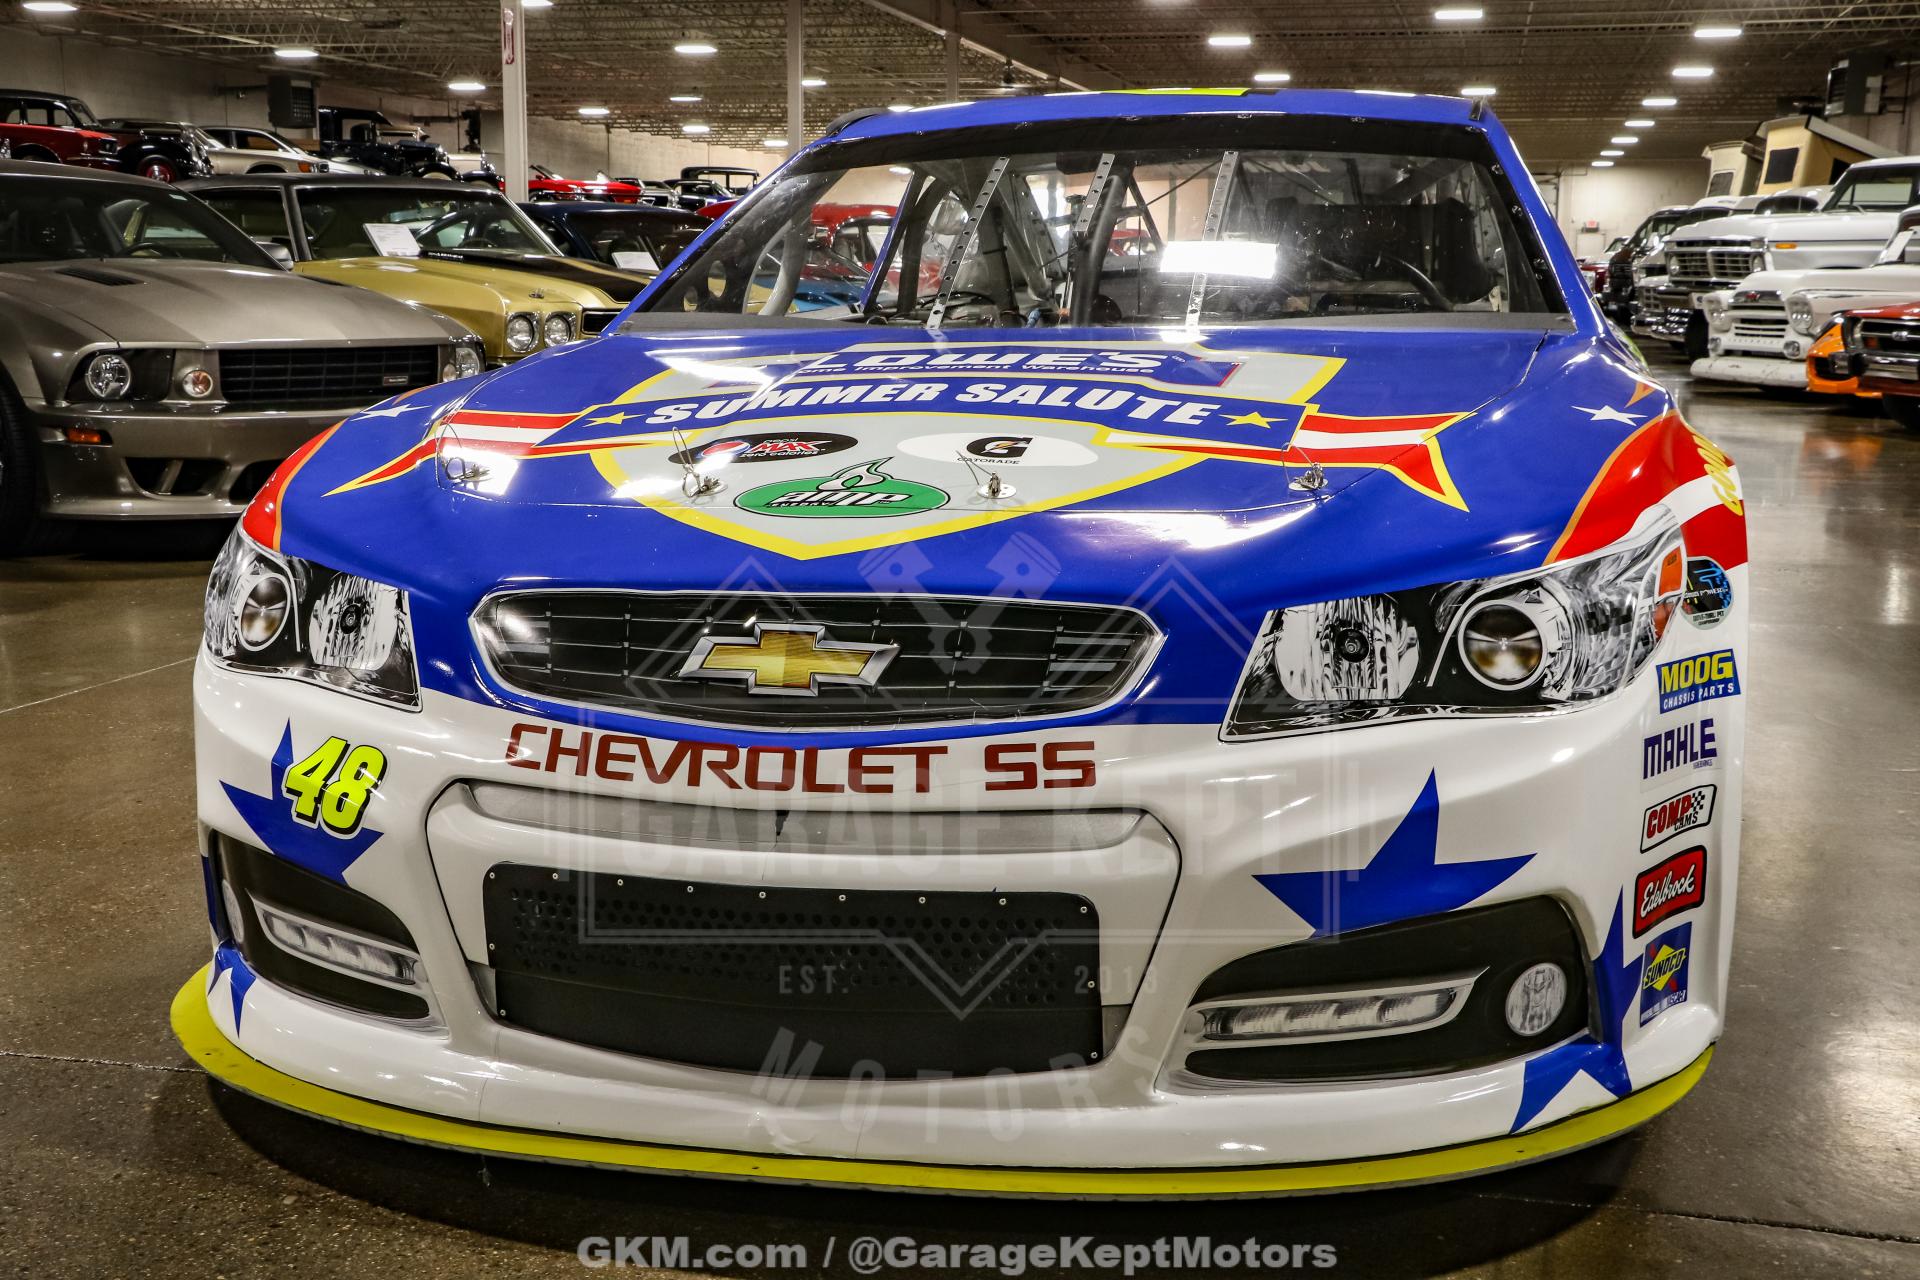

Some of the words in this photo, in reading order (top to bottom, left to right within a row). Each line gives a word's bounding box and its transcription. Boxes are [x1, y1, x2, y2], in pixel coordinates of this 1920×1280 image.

[802, 351, 1168, 369] LOWE'S
[854, 364, 1011, 372] Improvement
[1022, 364, 1155, 374] Warehouse
[645, 383, 948, 424] SUMMER
[955, 383, 1222, 425] SALUTE
[745, 440, 832, 452] MAX
[769, 449, 819, 457] calories
[957, 457, 1021, 465] GATORADE
[966, 436, 1034, 458] G
[1660, 651, 1734, 695] MOOG
[1663, 690, 1696, 710] CHASSIS
[1698, 682, 1735, 699] PARTS
[504, 722, 949, 793] CHEVROLET
[984, 740, 1097, 791] SS
[1642, 717, 1718, 780] MAHLE
[284, 735, 388, 836] 48
[1646, 794, 1692, 840] COMP
[1674, 810, 1699, 832] CAMS
[1640, 864, 1696, 918] Edelbrock
[1642, 949, 1686, 989] SUNOCO
